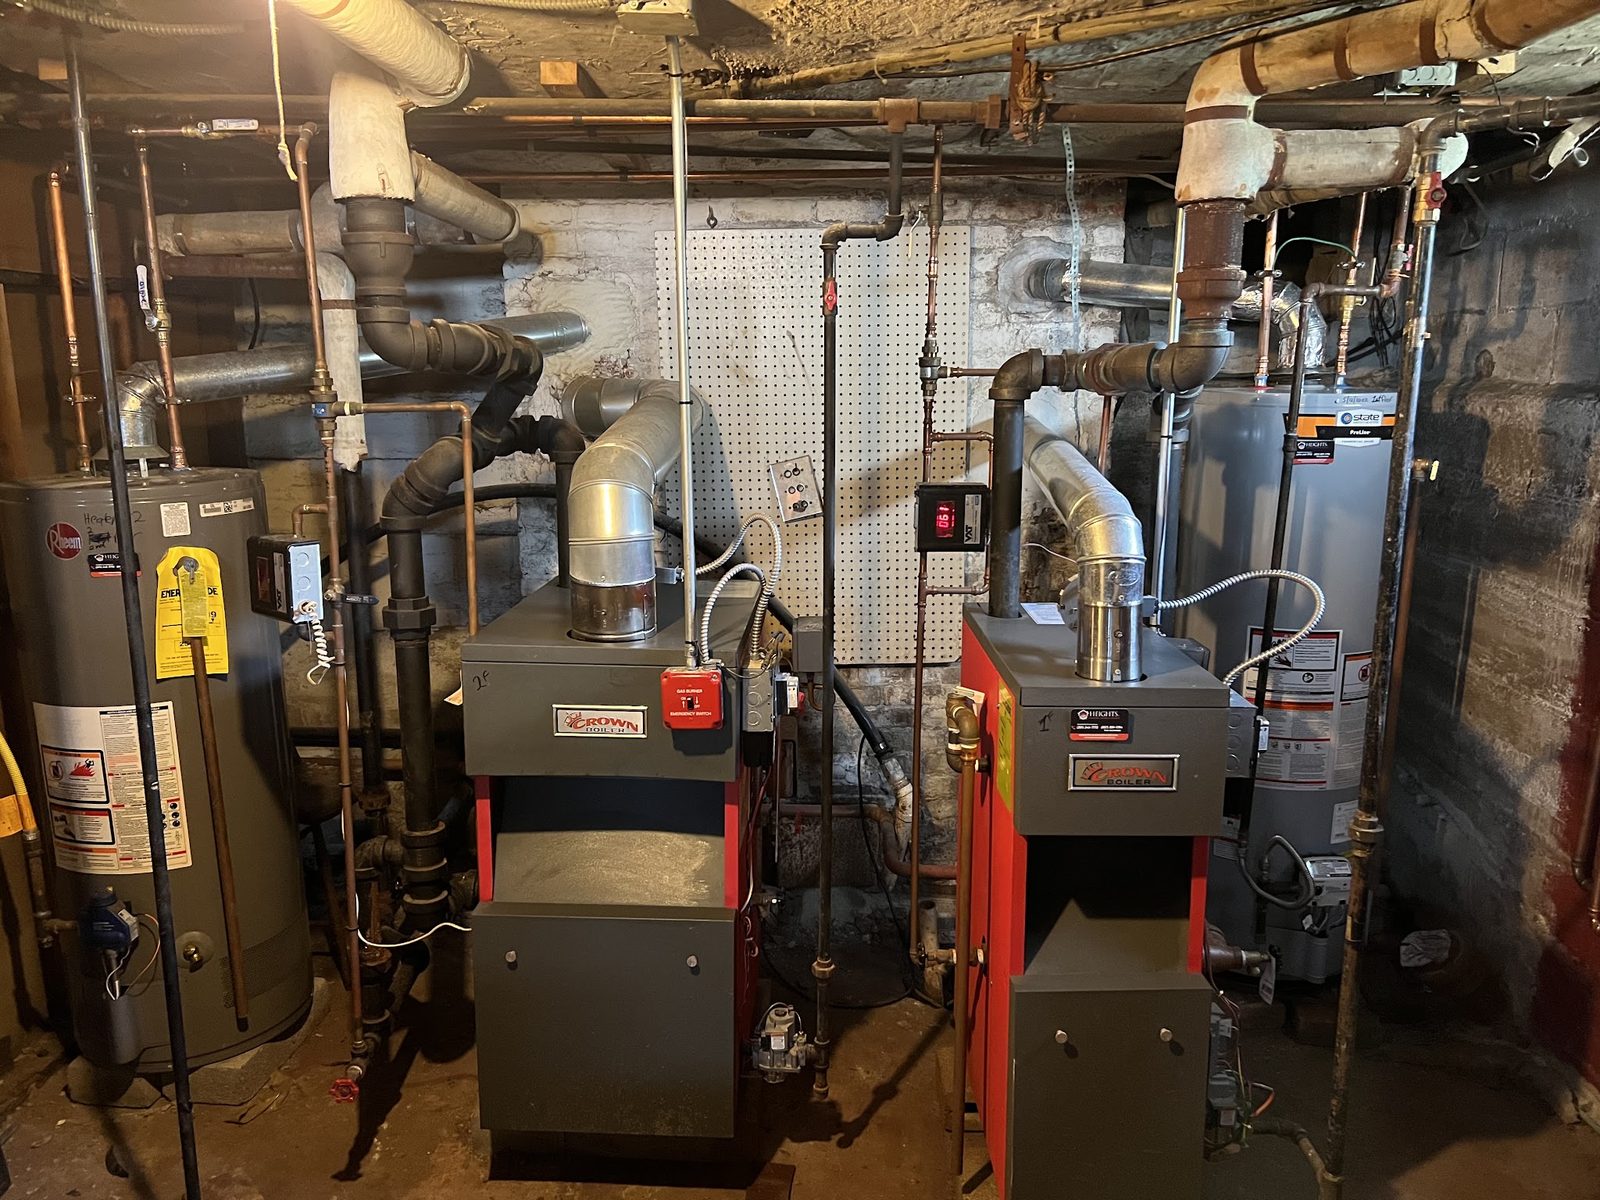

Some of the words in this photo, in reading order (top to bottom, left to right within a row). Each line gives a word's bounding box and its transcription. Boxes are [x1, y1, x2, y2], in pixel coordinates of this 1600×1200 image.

[1353, 413, 1380, 421] state
[49, 523, 81, 554] Rheem
[572, 716, 639, 733] CROWN
[1090, 766, 1167, 784] CROWN
